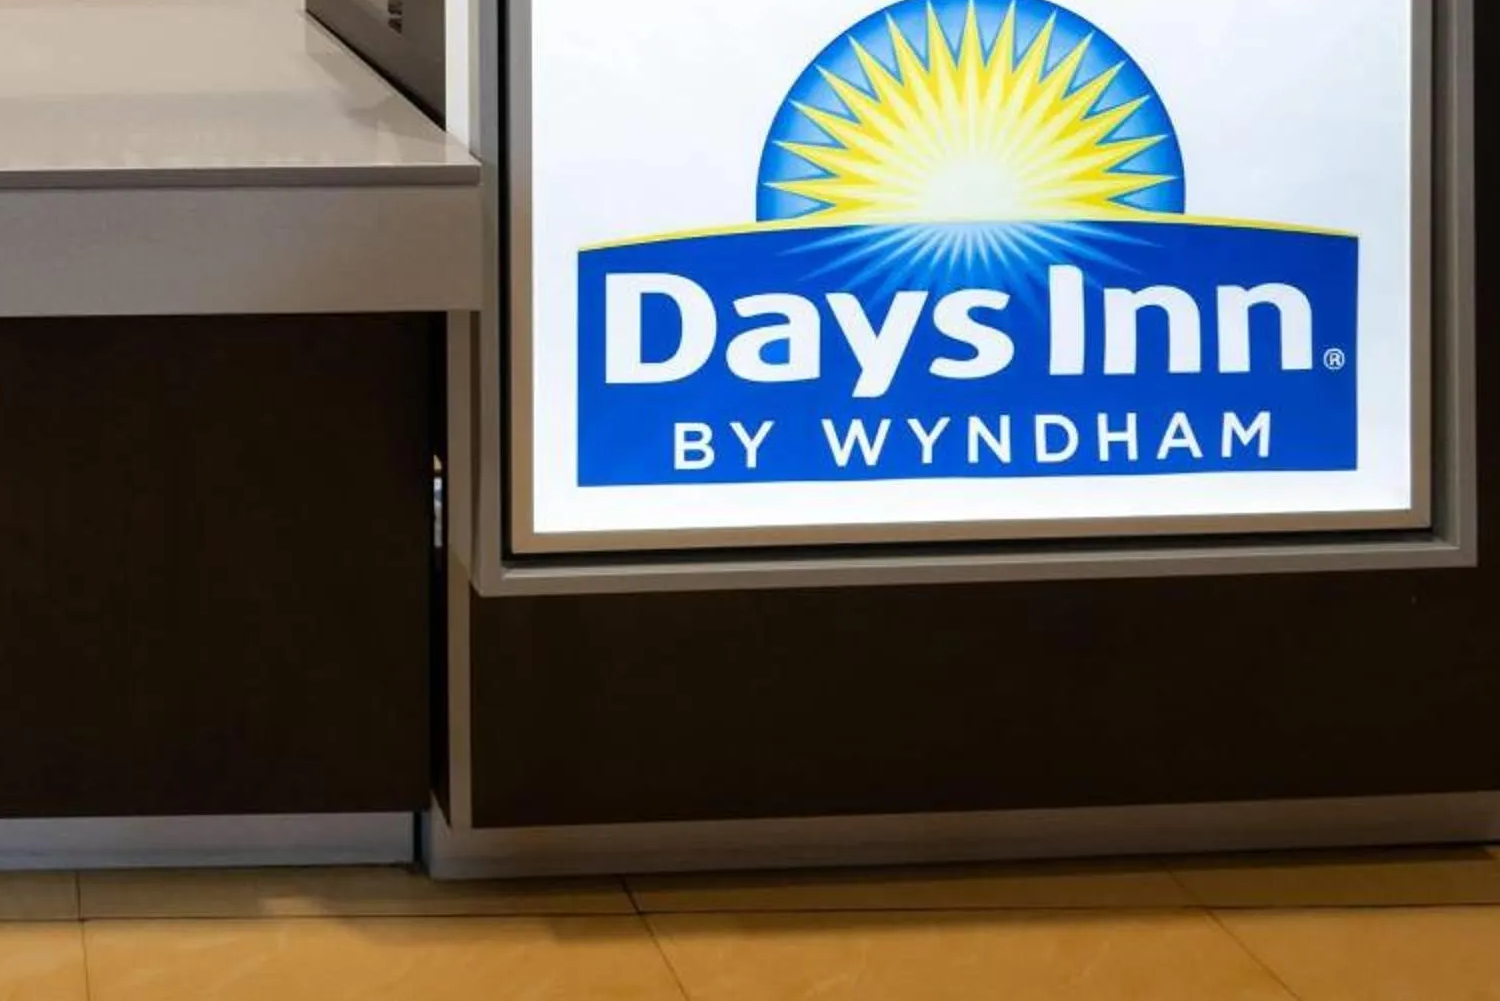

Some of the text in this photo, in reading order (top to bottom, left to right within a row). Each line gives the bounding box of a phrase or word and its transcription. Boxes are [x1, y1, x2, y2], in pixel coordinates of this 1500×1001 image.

[605, 272, 1014, 398] Days
[674, 411, 1271, 470] BY WYNDHAM
